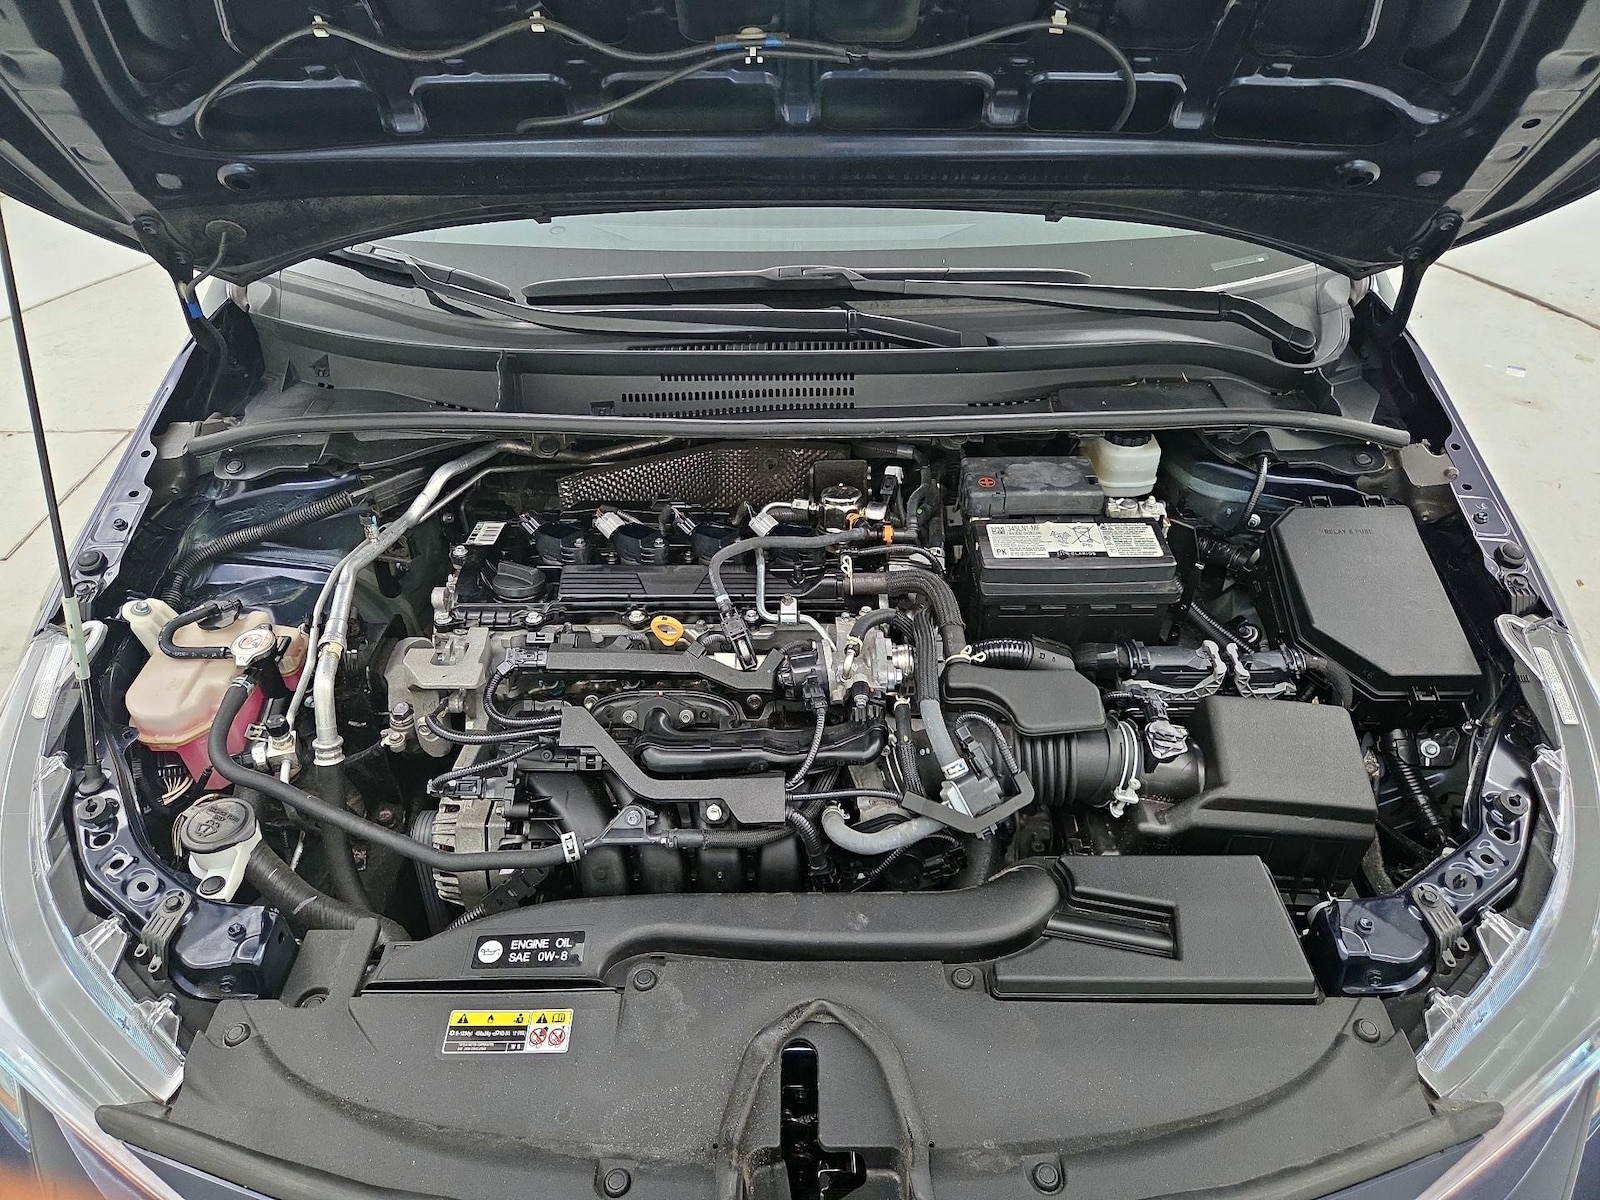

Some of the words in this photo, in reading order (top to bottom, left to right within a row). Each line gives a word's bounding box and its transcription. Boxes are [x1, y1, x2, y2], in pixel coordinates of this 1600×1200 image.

[996, 548, 1007, 556] PK
[510, 939, 550, 950] ENGINE
[555, 937, 573, 948] OIL
[508, 952, 531, 963] SAE
[537, 951, 569, 961] 0W-8
